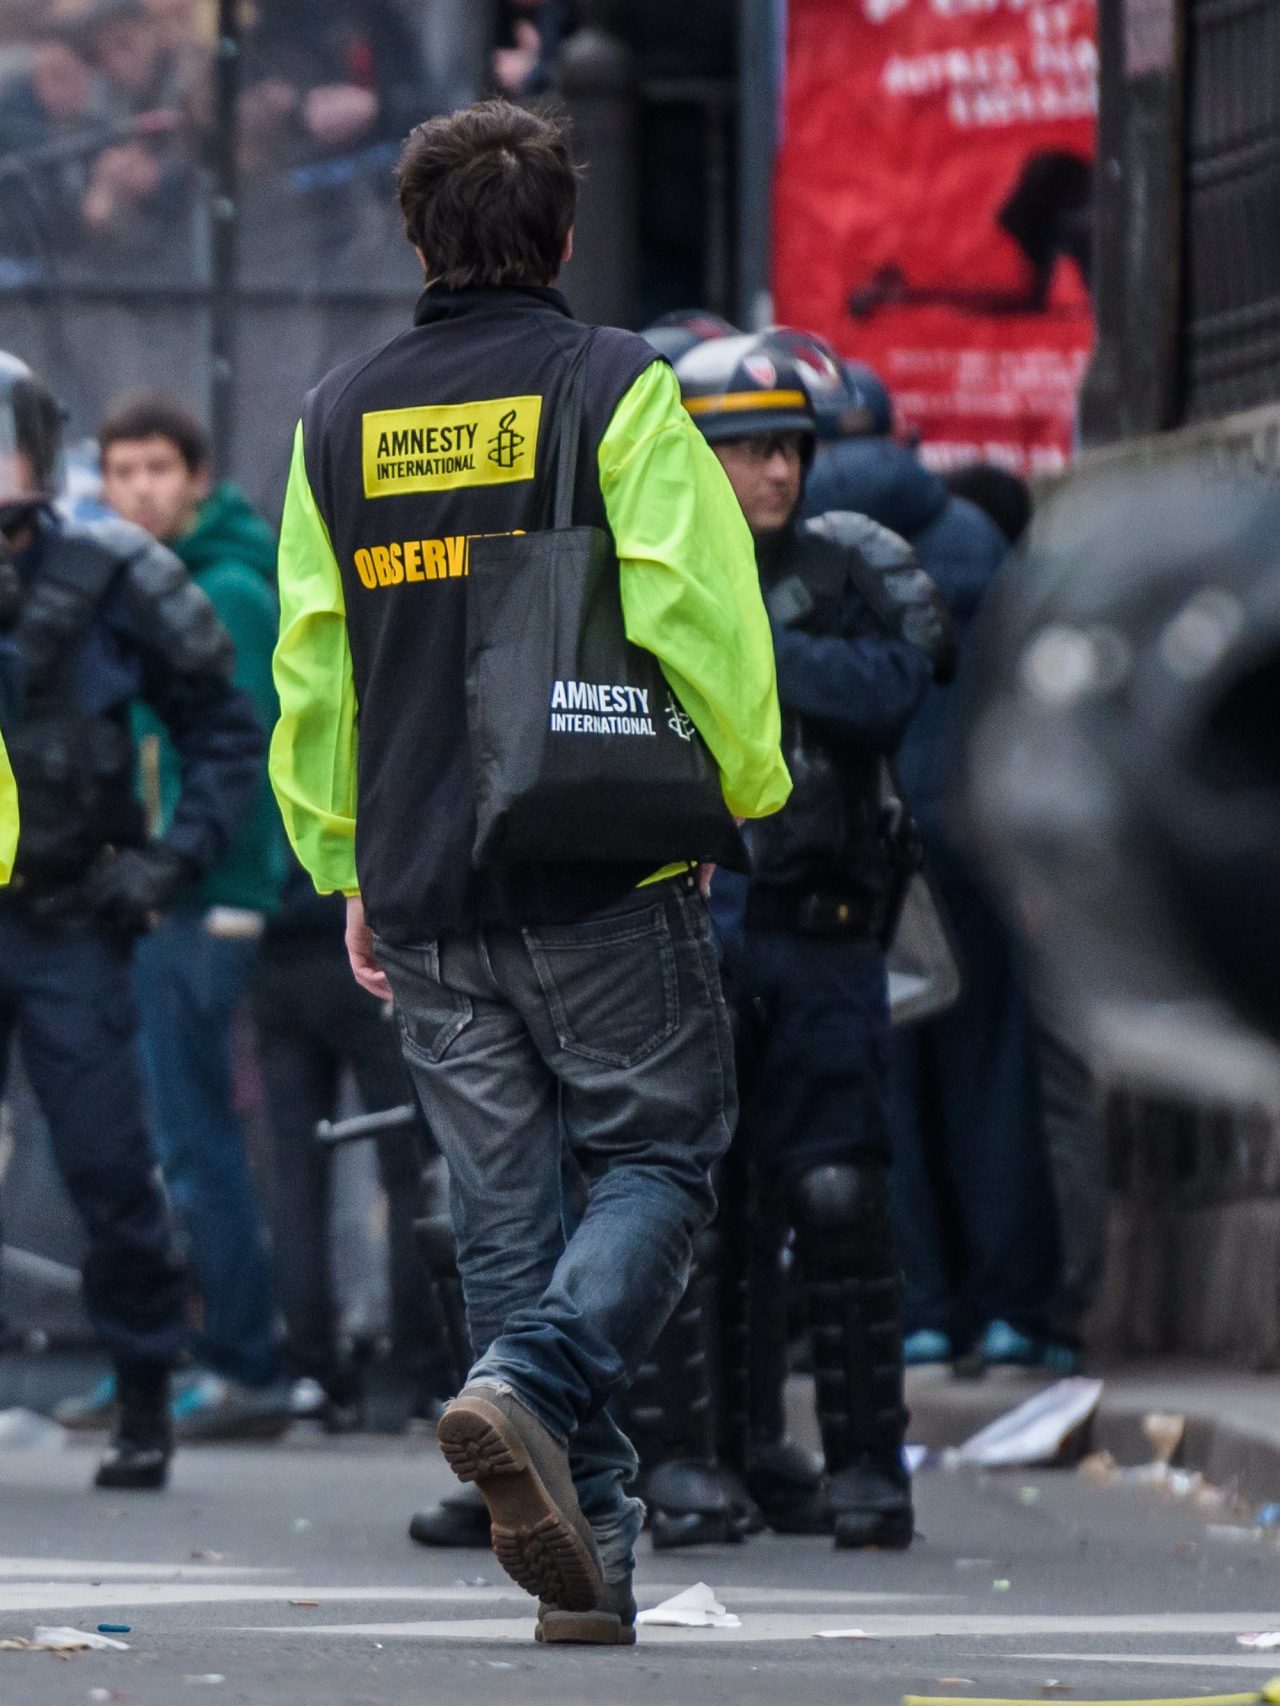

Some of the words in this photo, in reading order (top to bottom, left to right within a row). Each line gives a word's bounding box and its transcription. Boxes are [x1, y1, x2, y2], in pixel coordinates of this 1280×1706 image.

[376, 423, 478, 459] AMNESTY
[376, 454, 476, 480] INTERNATIONAL
[353, 530, 526, 590] OBSERV
[551, 680, 649, 714] AMNESTY
[551, 713, 657, 736] INTERNATIONAL
